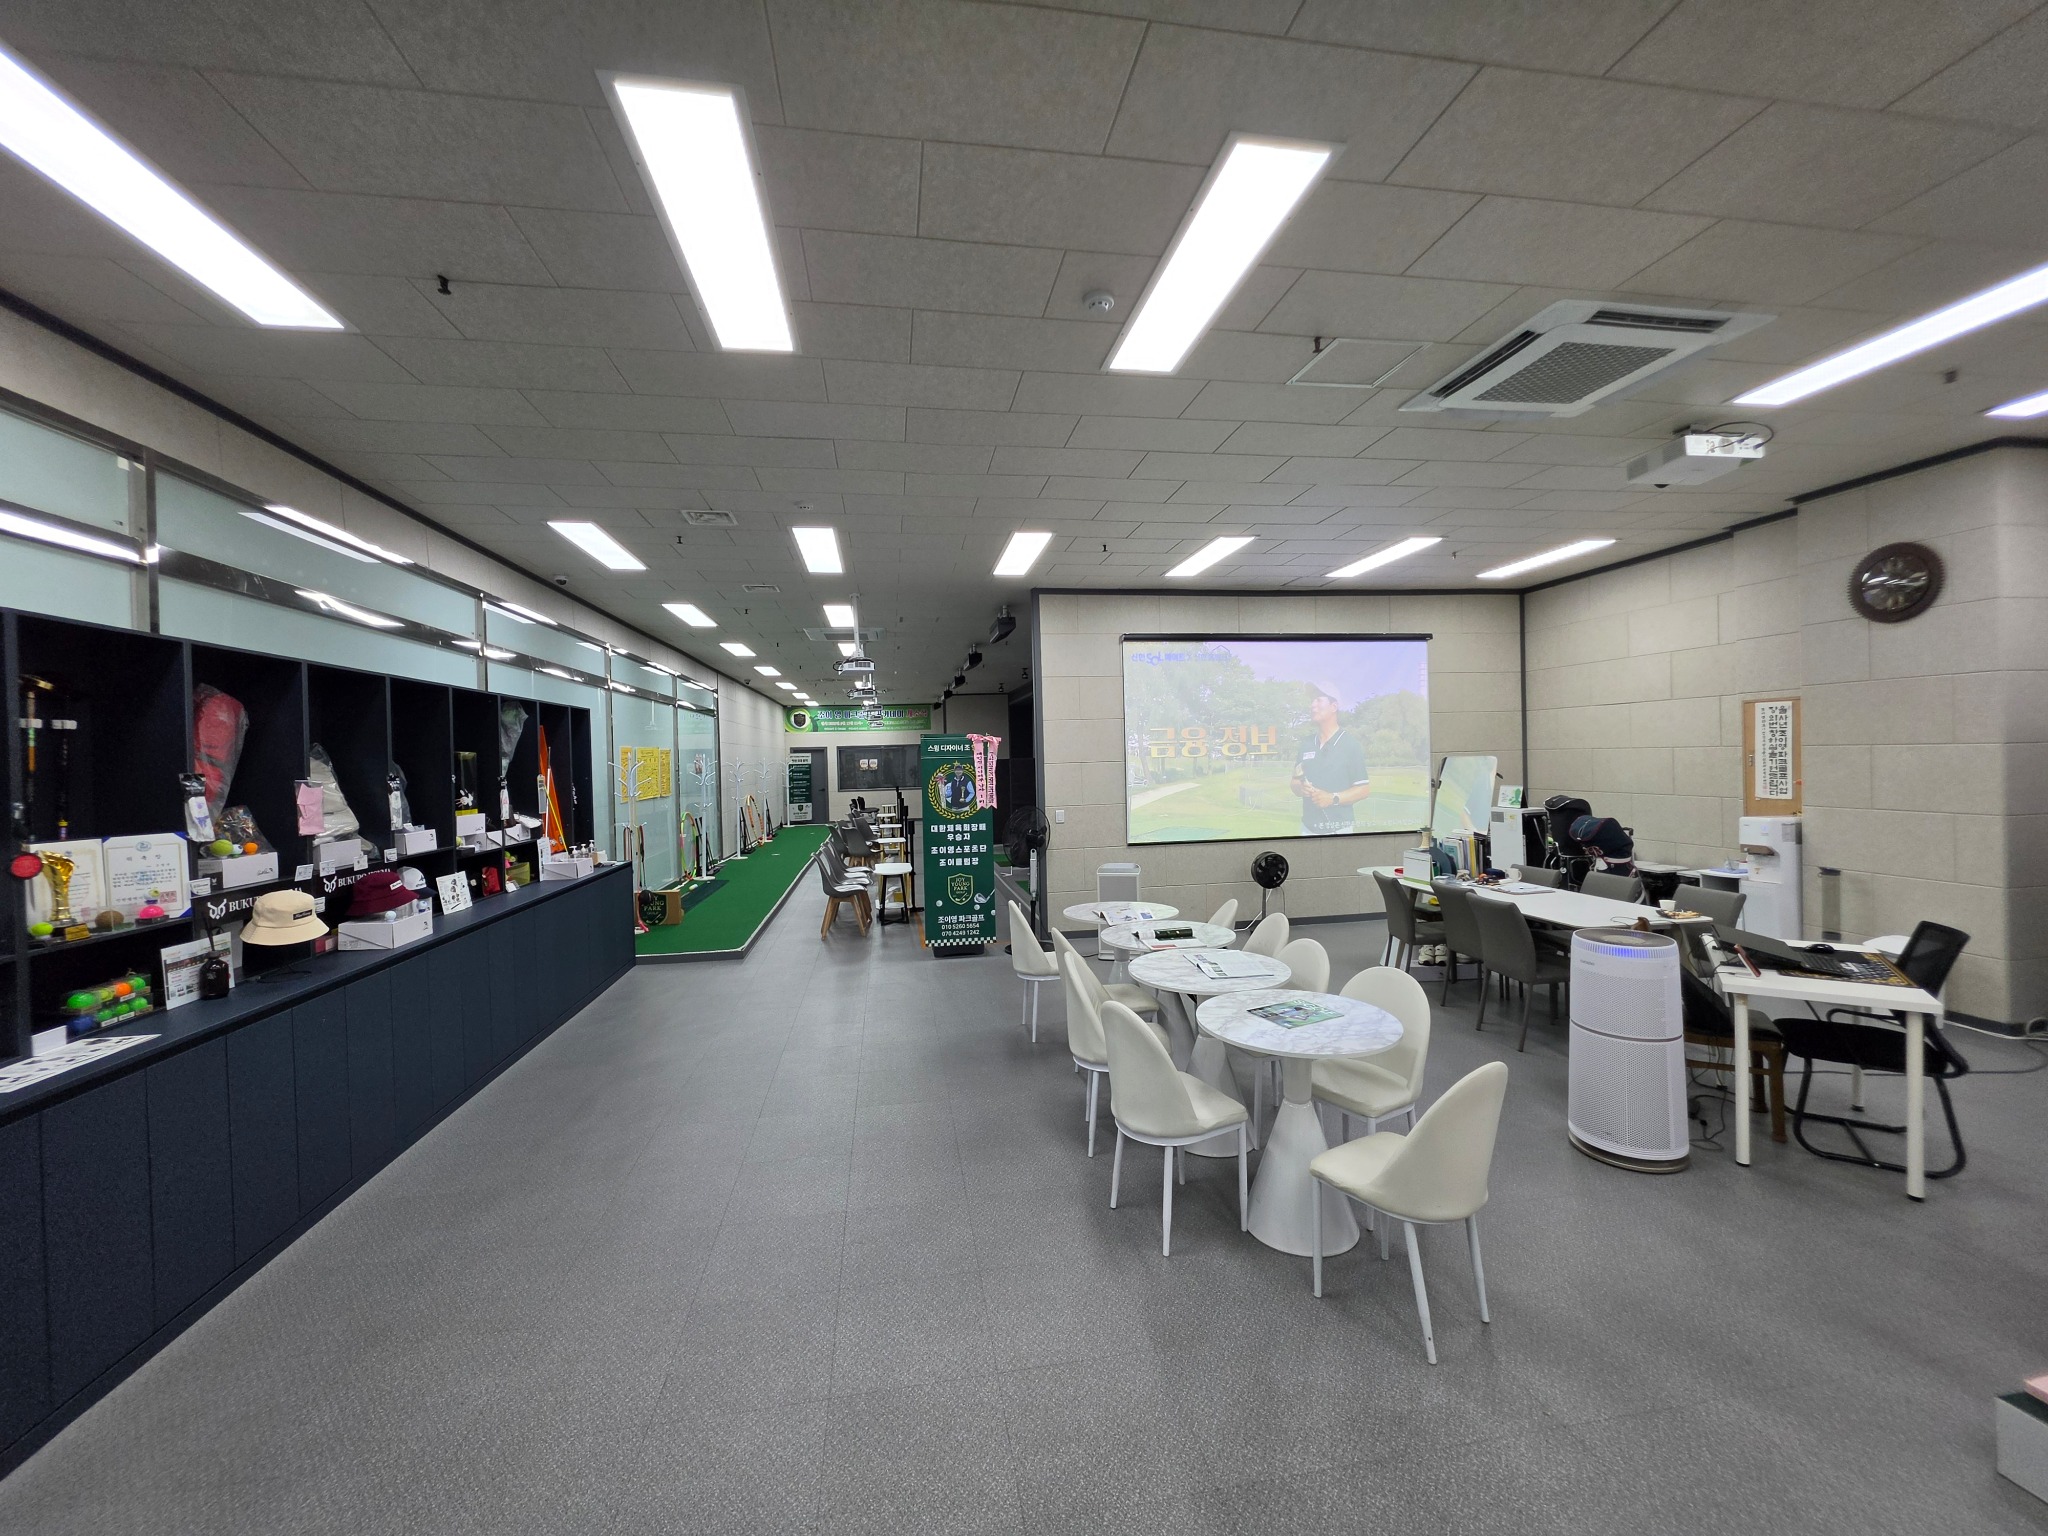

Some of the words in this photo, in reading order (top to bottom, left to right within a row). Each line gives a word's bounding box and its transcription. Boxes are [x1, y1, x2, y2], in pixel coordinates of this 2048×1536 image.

[1149, 725, 1208, 758] 금융
[1217, 724, 1279, 756] 정보
[927, 744, 940, 752] 스윙
[940, 744, 964, 752] 디자이너
[931, 823, 986, 832] 대한체육회장배
[947, 832, 971, 841] 우승자
[931, 845, 987, 854] 조이영스포츠단
[939, 857, 979, 867] 조이클럽장
[937, 915, 958, 924] 조이영
[958, 914, 985, 923] 파크골프
